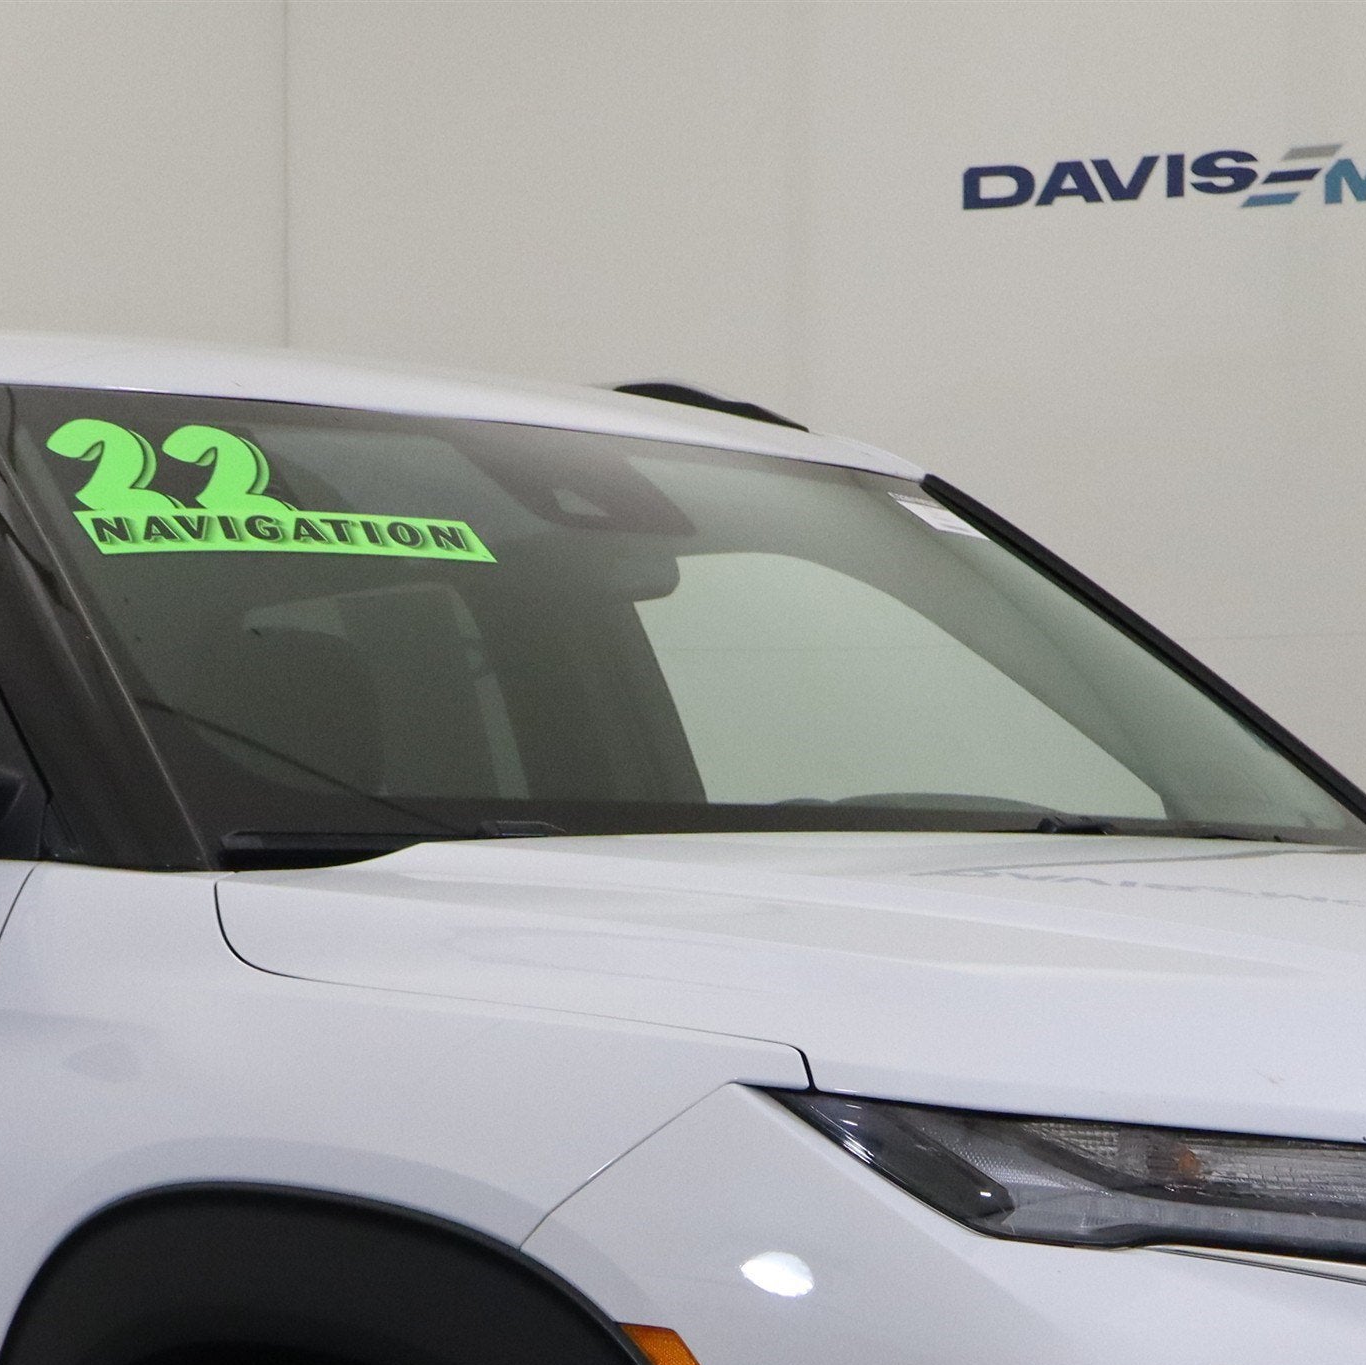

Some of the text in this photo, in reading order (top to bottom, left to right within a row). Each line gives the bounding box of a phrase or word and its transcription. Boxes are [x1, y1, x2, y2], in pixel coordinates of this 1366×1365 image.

[962, 148, 1260, 211] DAVIS
[46, 418, 299, 511] 22
[90, 514, 470, 551] NAVIGATION
